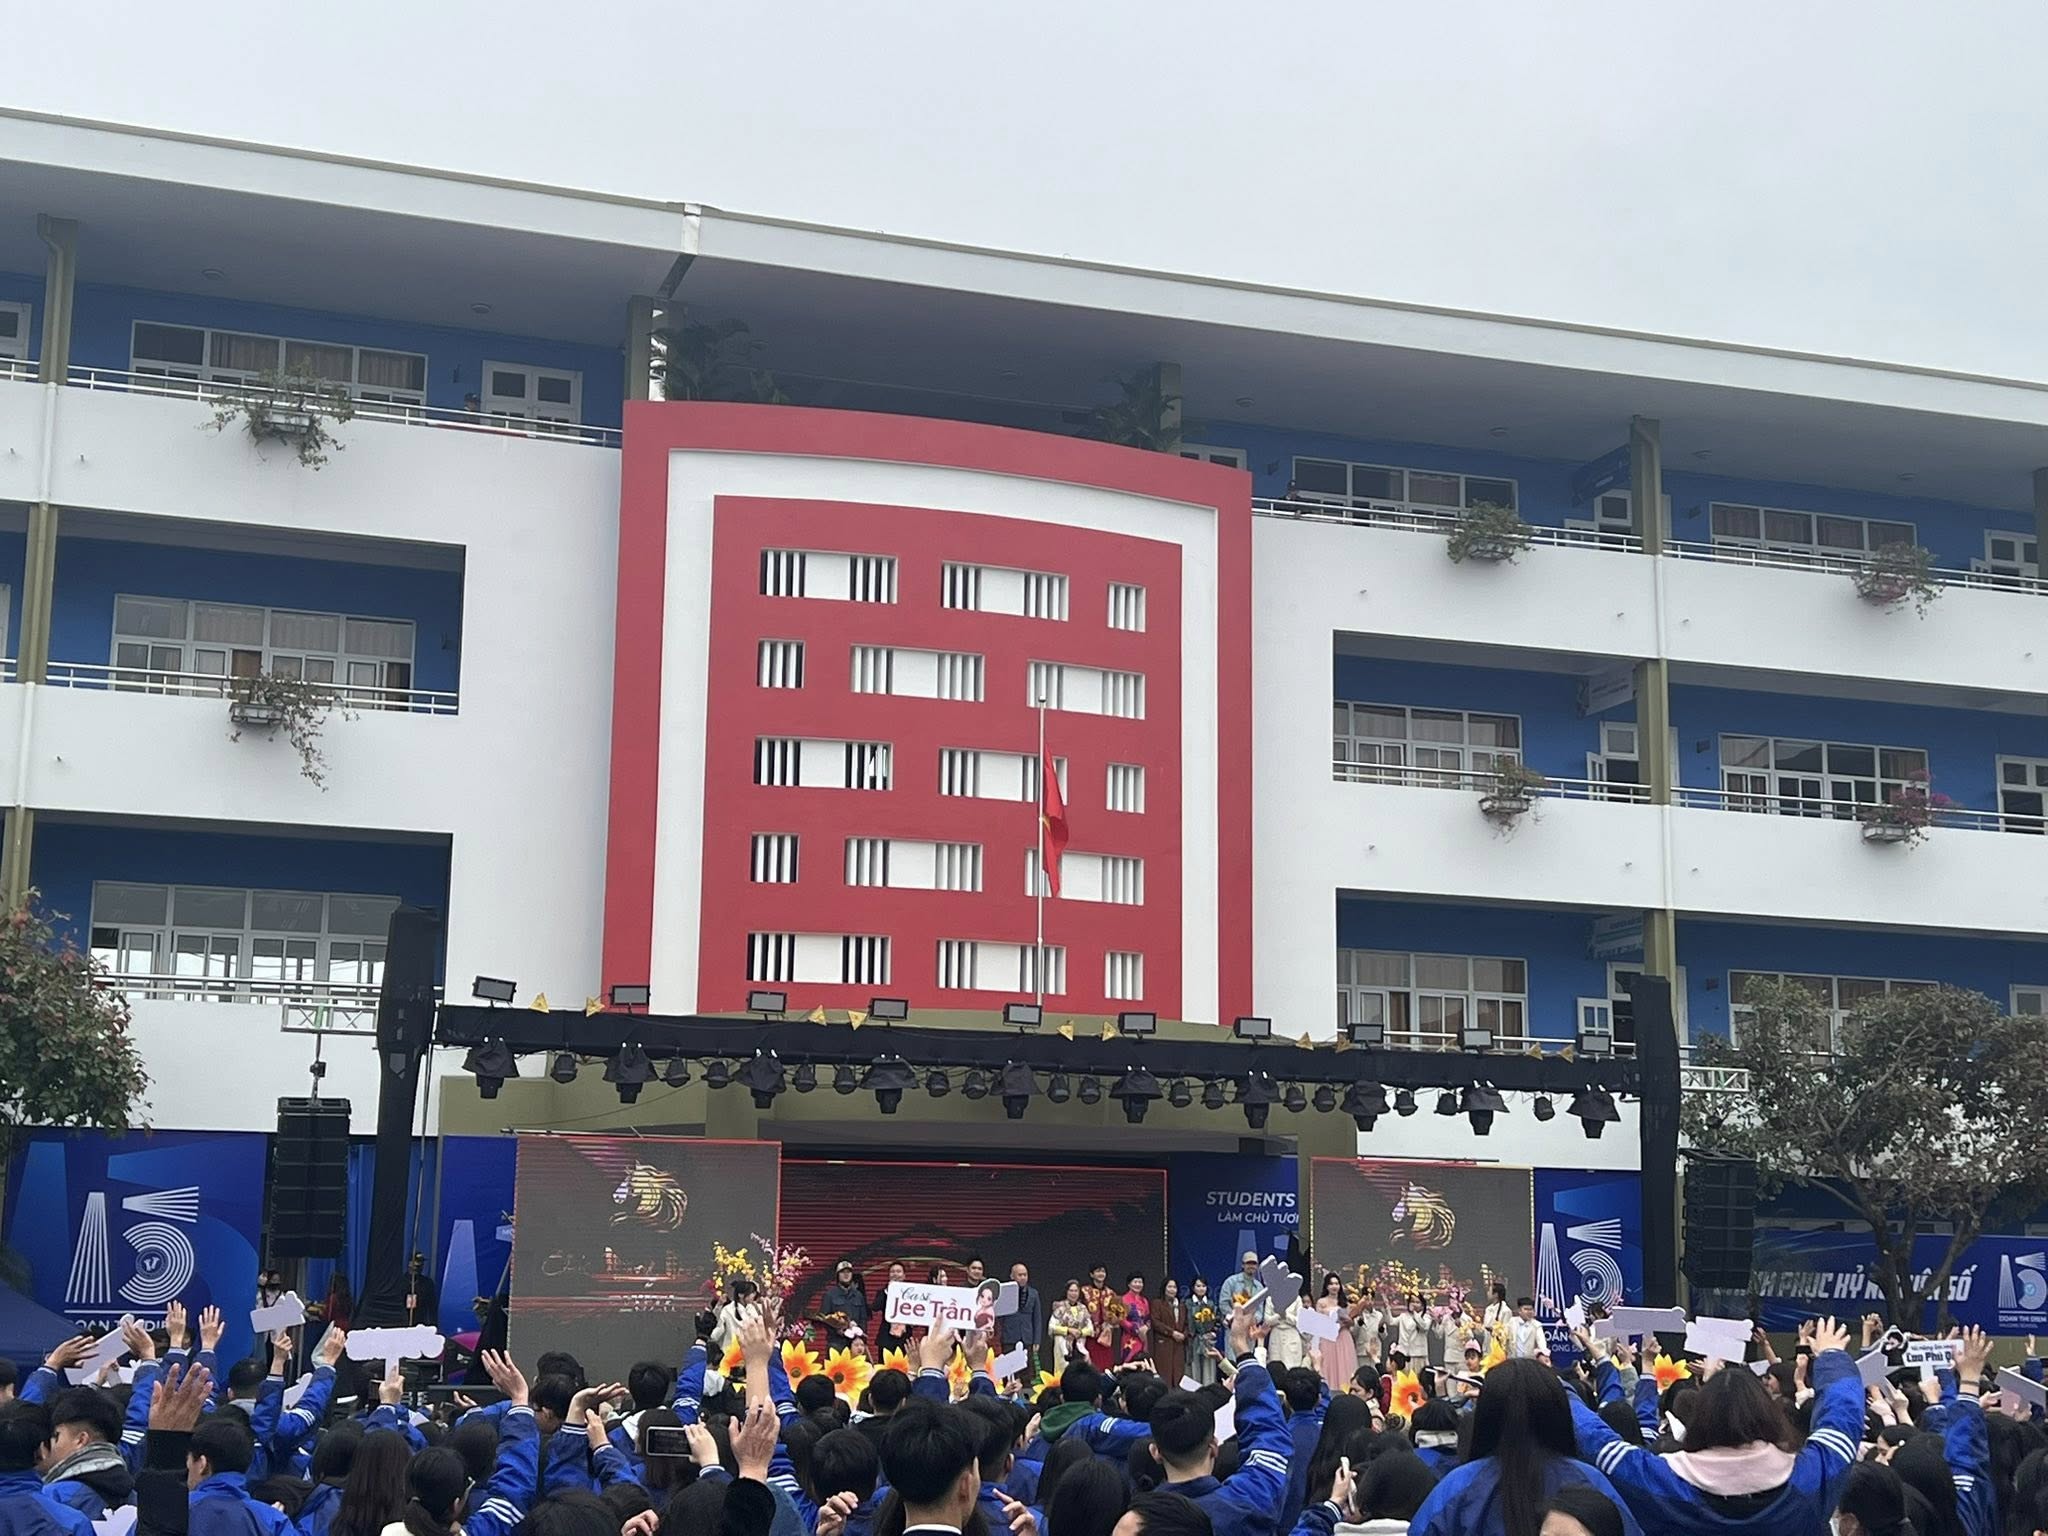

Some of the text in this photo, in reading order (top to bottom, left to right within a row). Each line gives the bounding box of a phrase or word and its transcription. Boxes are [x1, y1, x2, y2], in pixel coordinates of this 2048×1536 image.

[1206, 1191, 1296, 1208] STUDENTS
[1218, 1210, 1242, 1222] LÀM
[1244, 1210, 1270, 1223] CHỦ
[1778, 1270, 1834, 1304] PHỤC
[1948, 1264, 1978, 1302] SỐ
[890, 1297, 972, 1321] Jee Trần
